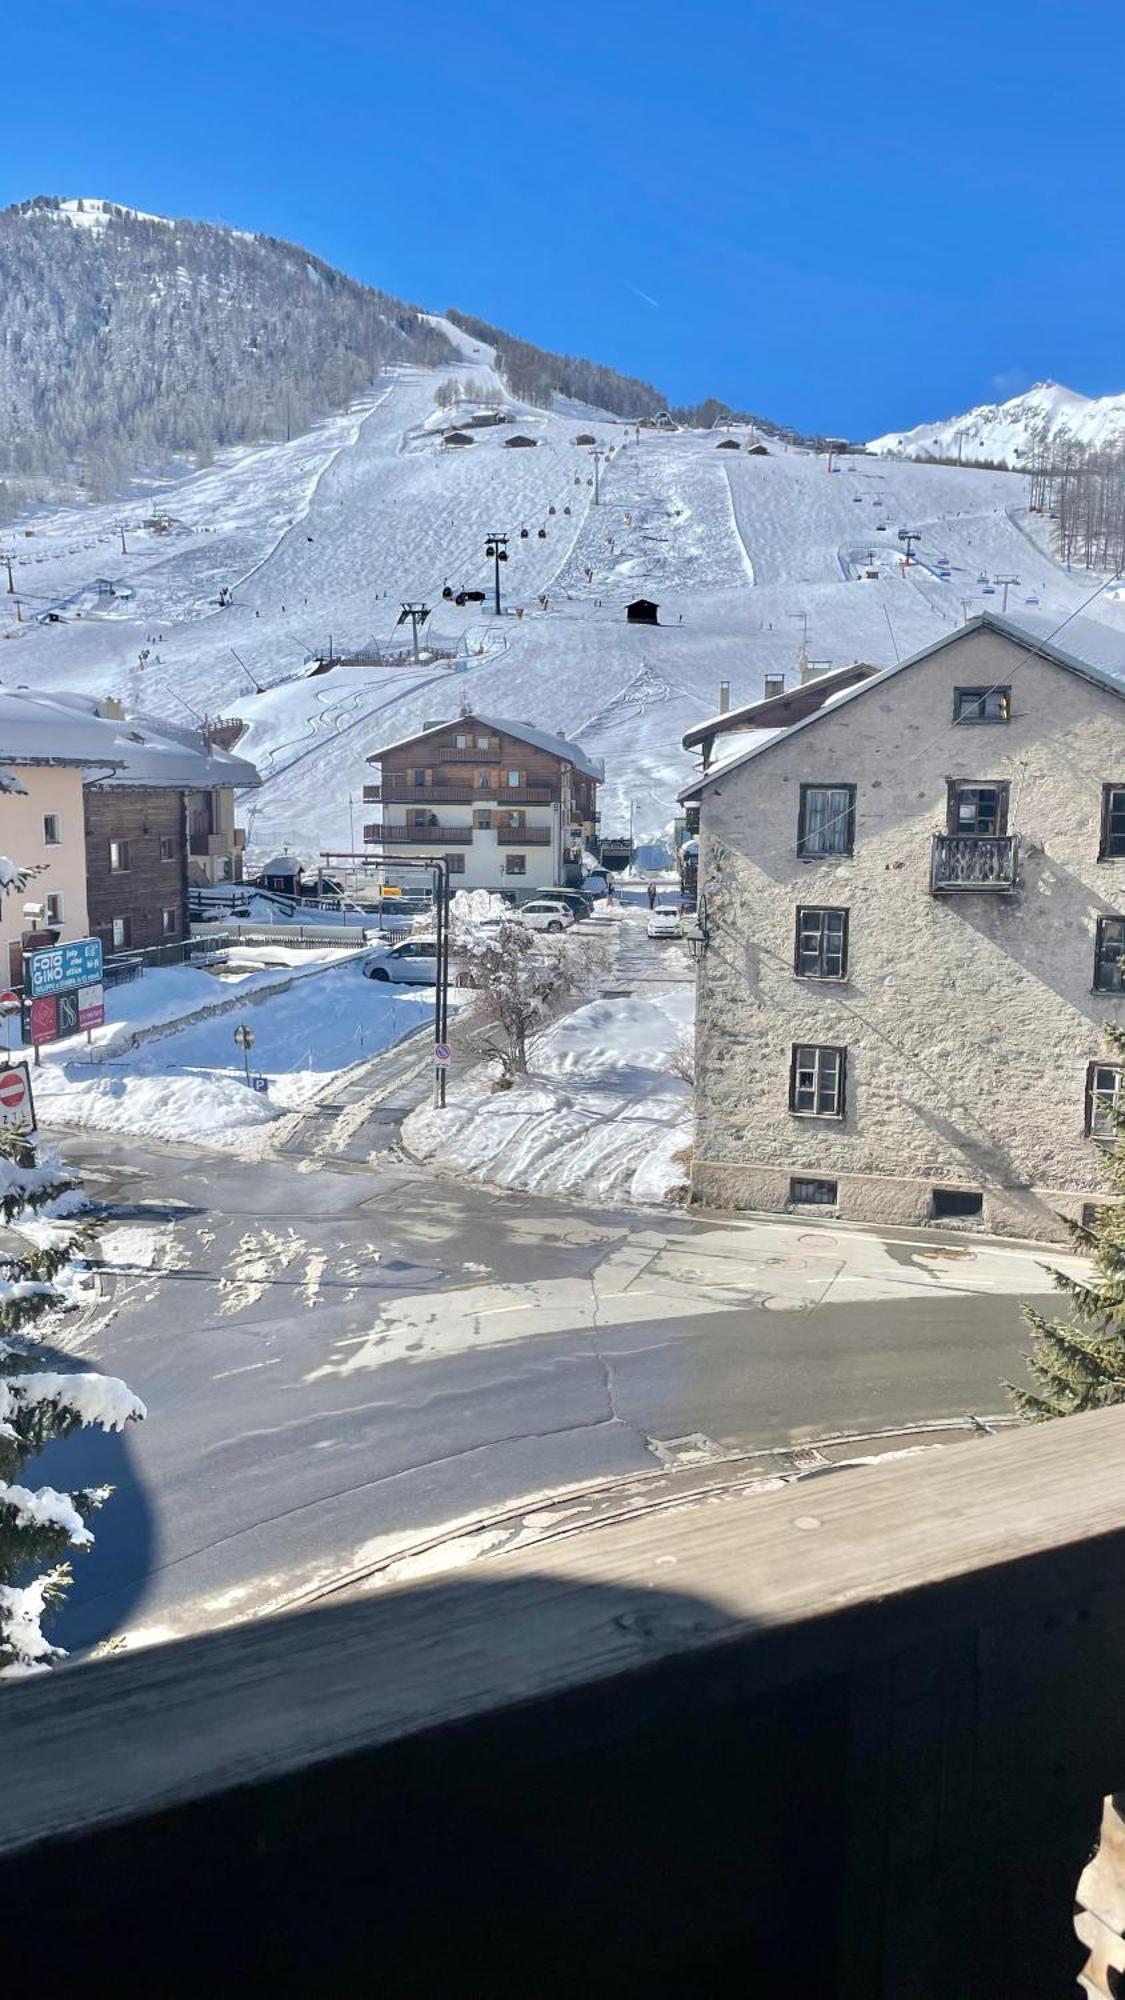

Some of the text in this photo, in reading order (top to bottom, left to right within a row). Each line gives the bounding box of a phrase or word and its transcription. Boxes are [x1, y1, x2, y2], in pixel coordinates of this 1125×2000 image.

[33, 951, 63, 972] FOTO
[34, 967, 63, 984] GINO
[256, 1080, 264, 1089] P
